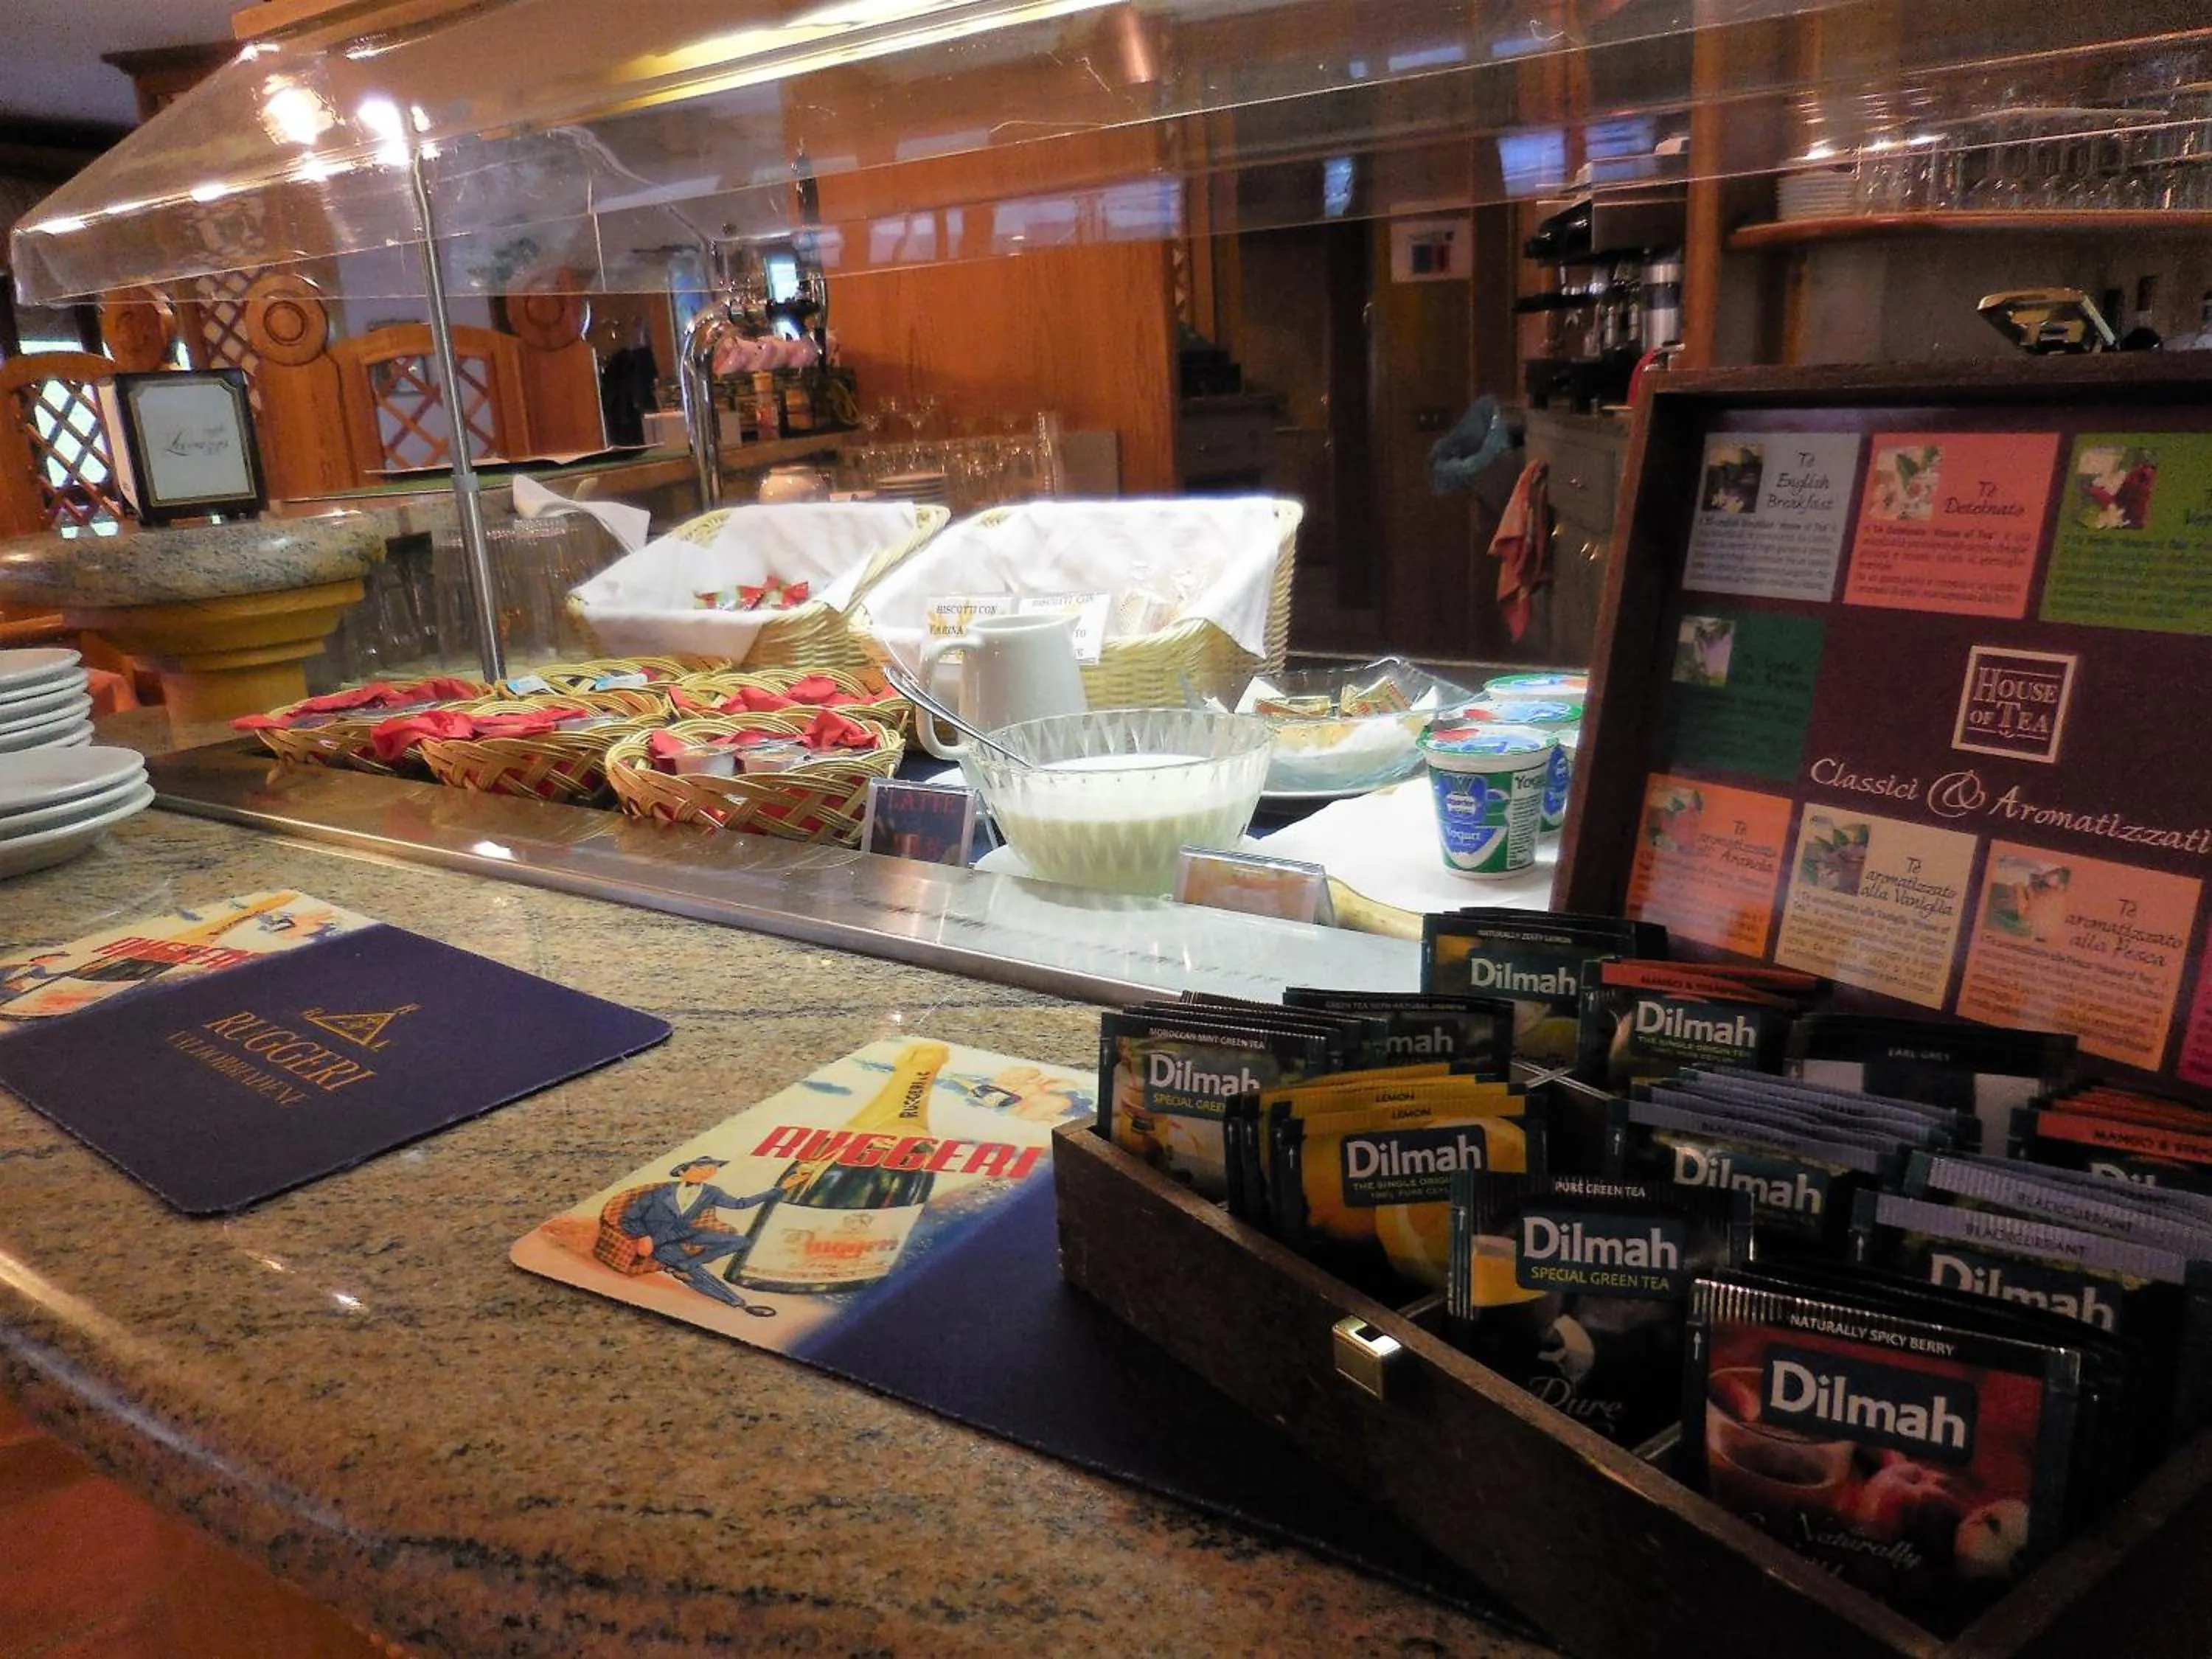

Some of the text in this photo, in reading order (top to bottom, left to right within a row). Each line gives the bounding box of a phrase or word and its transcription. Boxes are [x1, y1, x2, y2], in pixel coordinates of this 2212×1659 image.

[1776, 473, 1830, 495] English
[1767, 493, 1834, 515] Breakfast
[936, 605, 998, 615] BISCOTTI CON
[1973, 667, 2059, 703] HOUSE
[1969, 701, 2050, 733] OF TEA
[1810, 757, 2212, 855] Classici & Aromatizzati
[1860, 883, 1953, 919] alla Vaniglia
[1865, 869, 1957, 899] aromatizzato
[2065, 913, 2184, 950] aromatizzato
[2069, 932, 2167, 968] alla Pesca
[1471, 956, 1577, 996] Dilmah
[1149, 1026, 1266, 1050] MOROCCAN MINT GREEN TEA
[1386, 1026, 1454, 1054] mah
[1635, 1000, 1756, 1048] Dilmah
[200, 1009, 378, 1092] RUGGERI
[1888, 1046, 1951, 1062] EARL GREY
[1150, 1054, 1261, 1097] Dilmah
[1153, 1092, 1194, 1109] SPECIAL
[1375, 1093, 1415, 1103] LEMON
[1391, 1107, 1432, 1119] LEMON
[749, 1125, 1046, 1180] RUGGERI
[1346, 1134, 1482, 1179] Dilmah
[2094, 1129, 2154, 1148] MANGO
[1554, 1180, 1646, 1197] PURE GREEN TEA
[1672, 1146, 1822, 1214] Dilmah
[1523, 1215, 1678, 1271] Dilmah
[1530, 1265, 1671, 1291] SPECIAL GREEN TEA
[1790, 1314, 1955, 1357] NATURALLY SPICY BERRY
[1528, 1376, 1625, 1422] Pure
[1770, 1358, 1966, 1450] Dilmah
